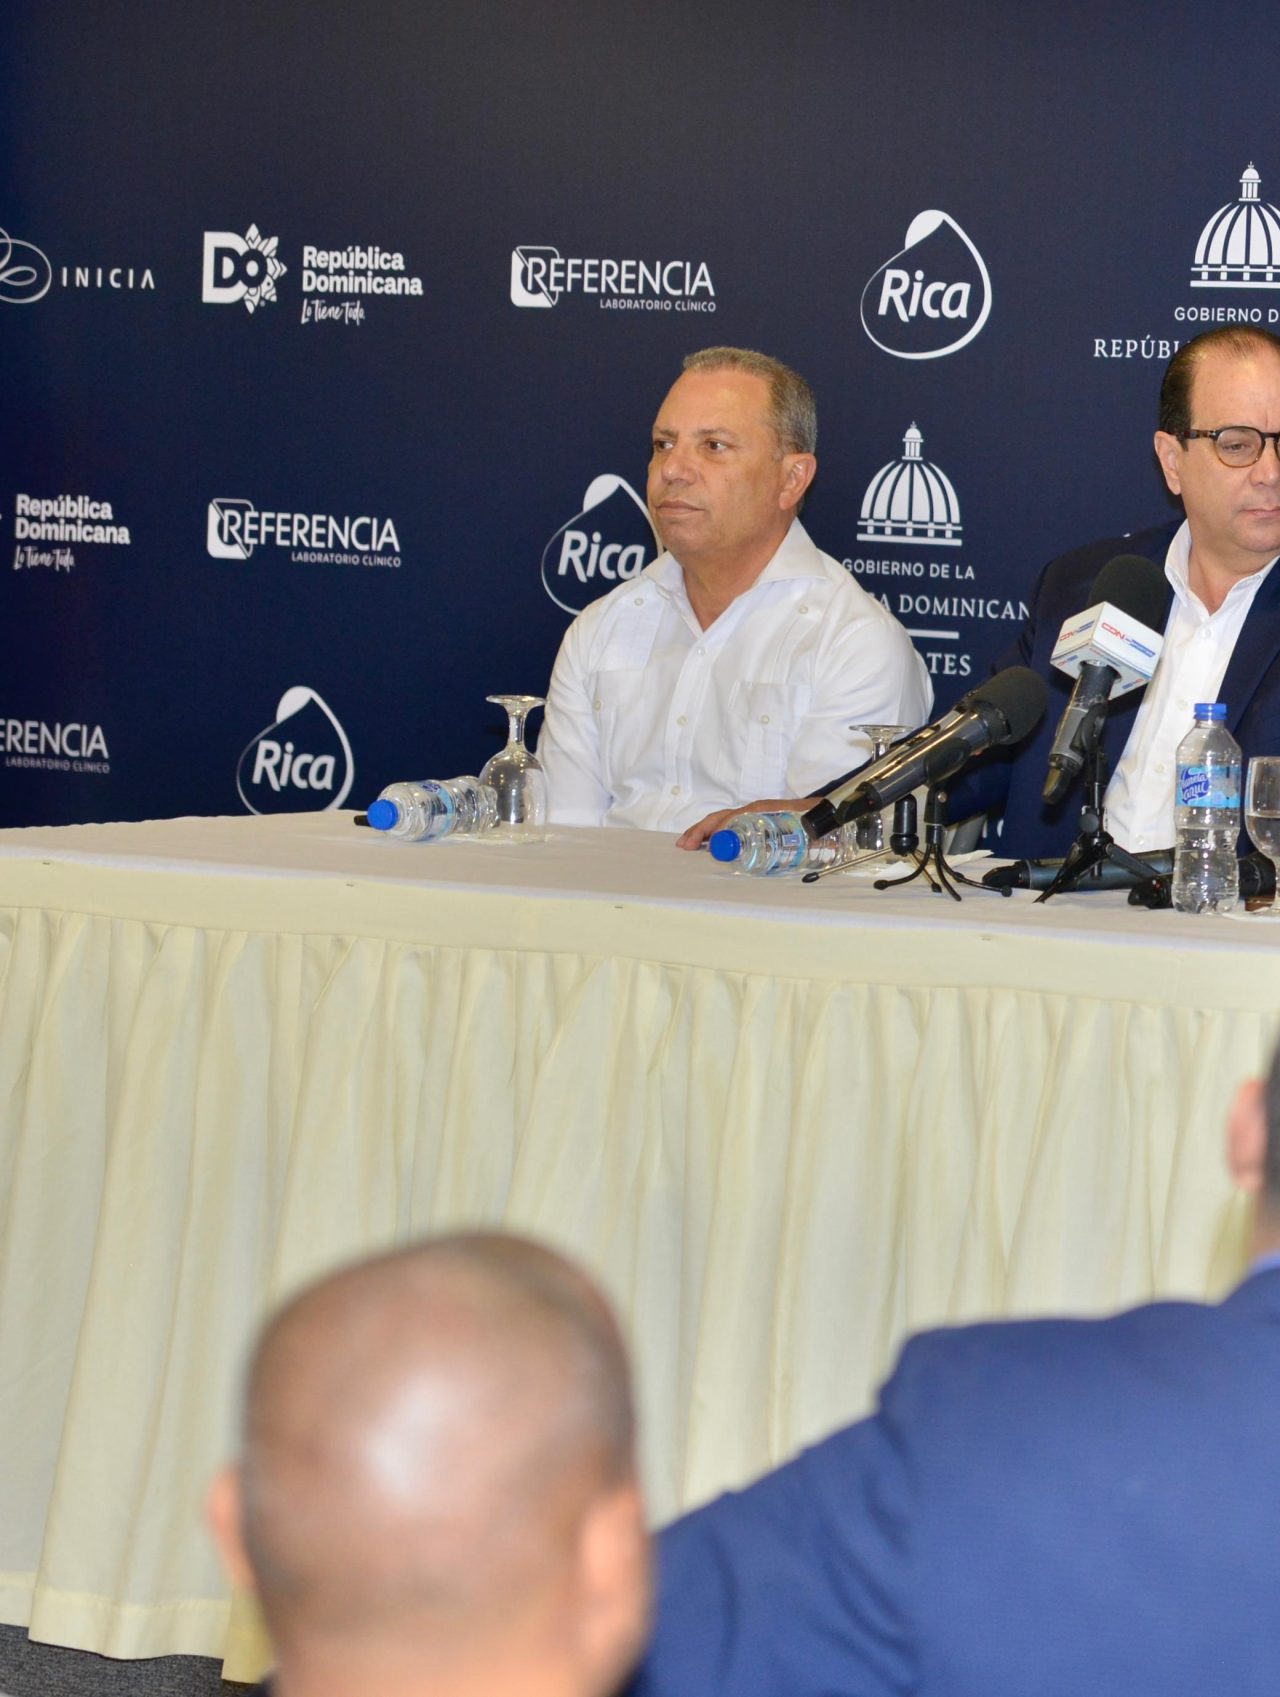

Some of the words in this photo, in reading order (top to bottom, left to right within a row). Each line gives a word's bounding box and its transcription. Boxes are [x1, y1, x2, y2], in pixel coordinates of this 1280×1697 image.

[303, 246, 405, 274] República
[62, 267, 154, 289] INICIA
[302, 270, 424, 296] Dominicana
[527, 257, 716, 297] REFERENCIA
[600, 299, 672, 310] LABORATORIO
[675, 300, 716, 312] CLÍNICO
[878, 269, 971, 323] Rica
[301, 299, 312, 324] Lo
[1175, 307, 1261, 322] GOBIERNO
[1093, 334, 1180, 359] REPÚB
[16, 493, 114, 522] República
[15, 517, 132, 545] Dominicana
[222, 509, 401, 553] REFERENCIA
[291, 551, 360, 566] LABORATORIO
[361, 554, 402, 569] CLÍNICO
[557, 530, 646, 583] Rica
[842, 558, 925, 577] GOBIERNO
[929, 563, 950, 578] DE
[954, 564, 976, 581] LA
[898, 594, 1031, 621] DOMINICAN
[0, 718, 110, 760] RENCIA
[251, 740, 337, 792] Rica
